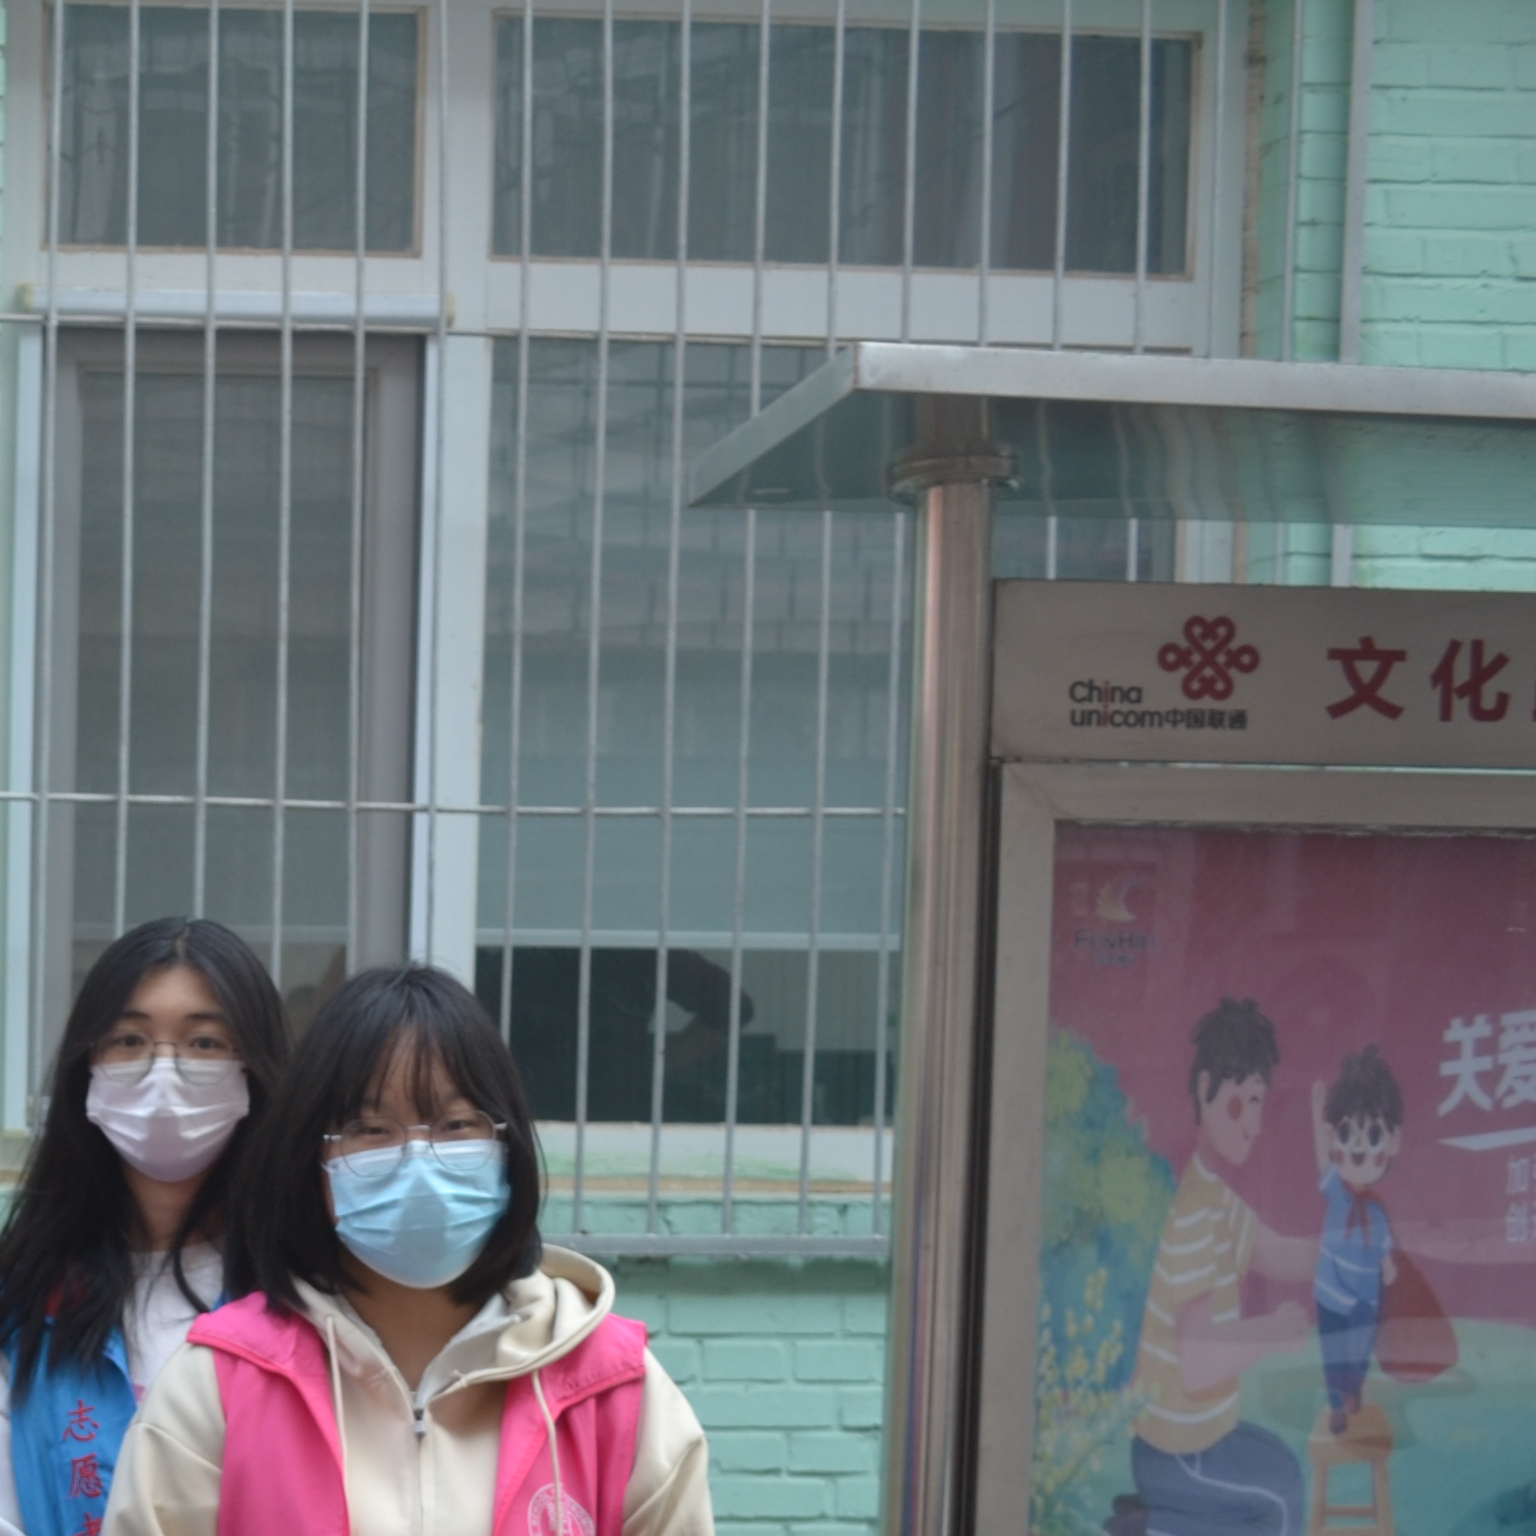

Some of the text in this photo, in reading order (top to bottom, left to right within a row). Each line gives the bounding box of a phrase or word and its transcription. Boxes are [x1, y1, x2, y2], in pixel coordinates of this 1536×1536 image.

[1069, 679, 1143, 704] China
[1326, 636, 1536, 723] 文化
[1070, 704, 1248, 730] unicom 中国联通
